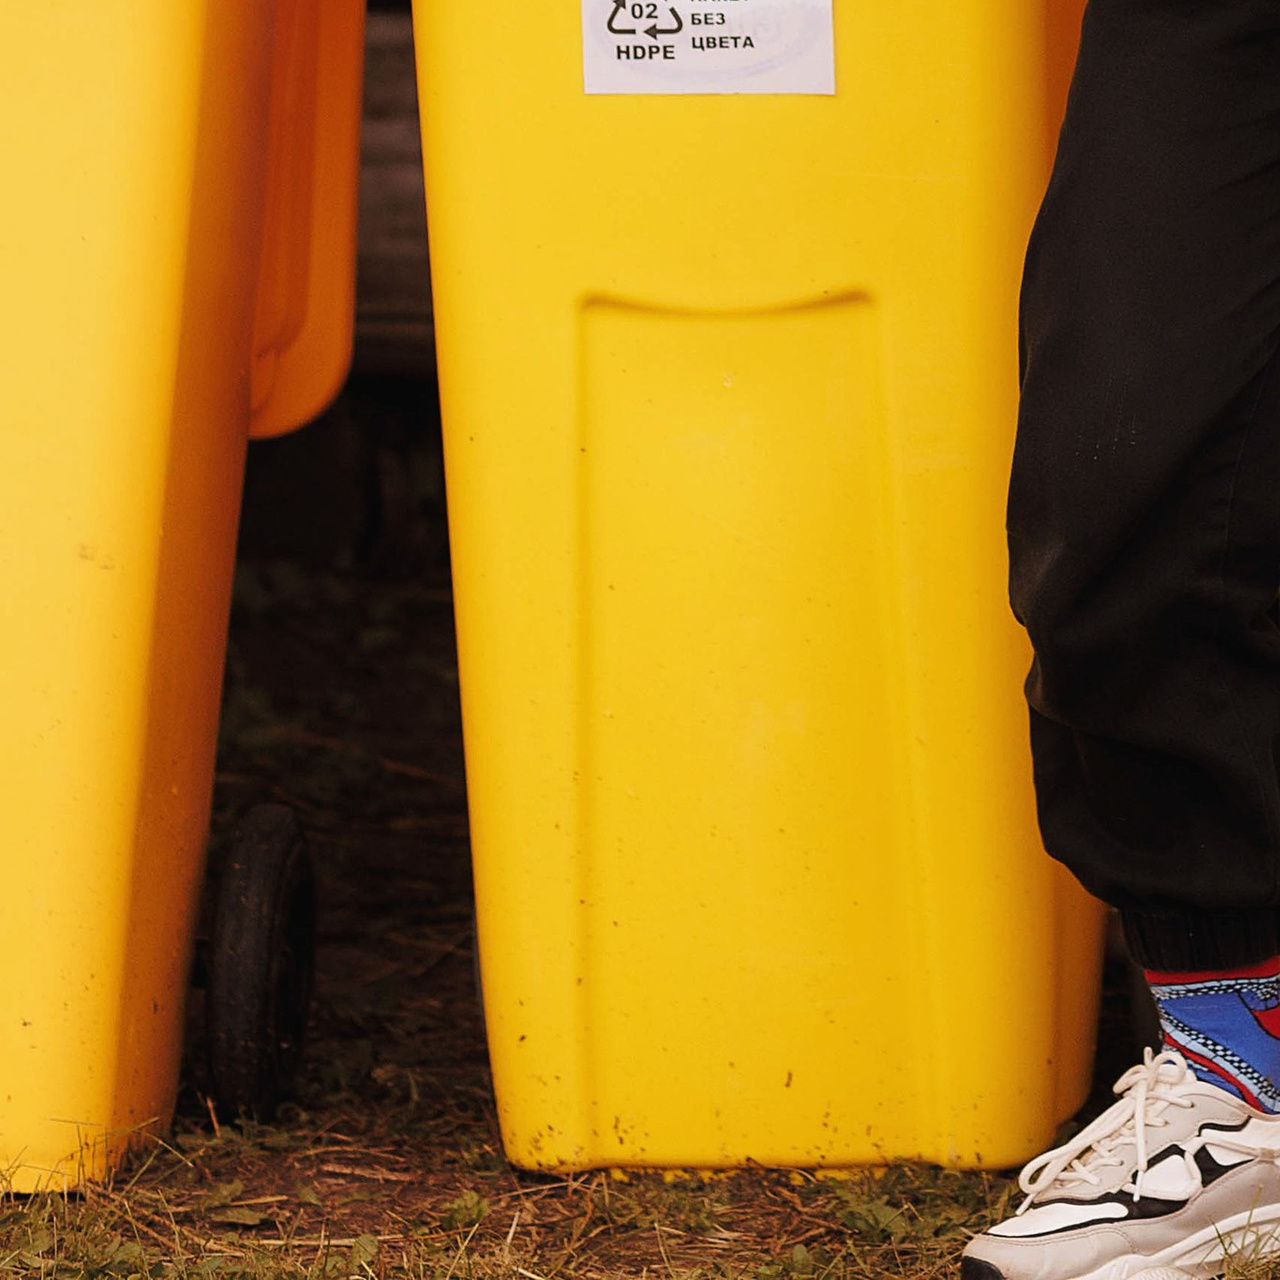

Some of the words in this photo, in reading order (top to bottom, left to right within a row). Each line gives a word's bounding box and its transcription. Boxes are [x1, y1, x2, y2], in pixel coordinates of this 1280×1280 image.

[630, 3, 659, 19] 02
[690, 12, 726, 26] БЕЗ
[691, 35, 755, 52] ЦВЕТА
[616, 44, 676, 60] HDPE
